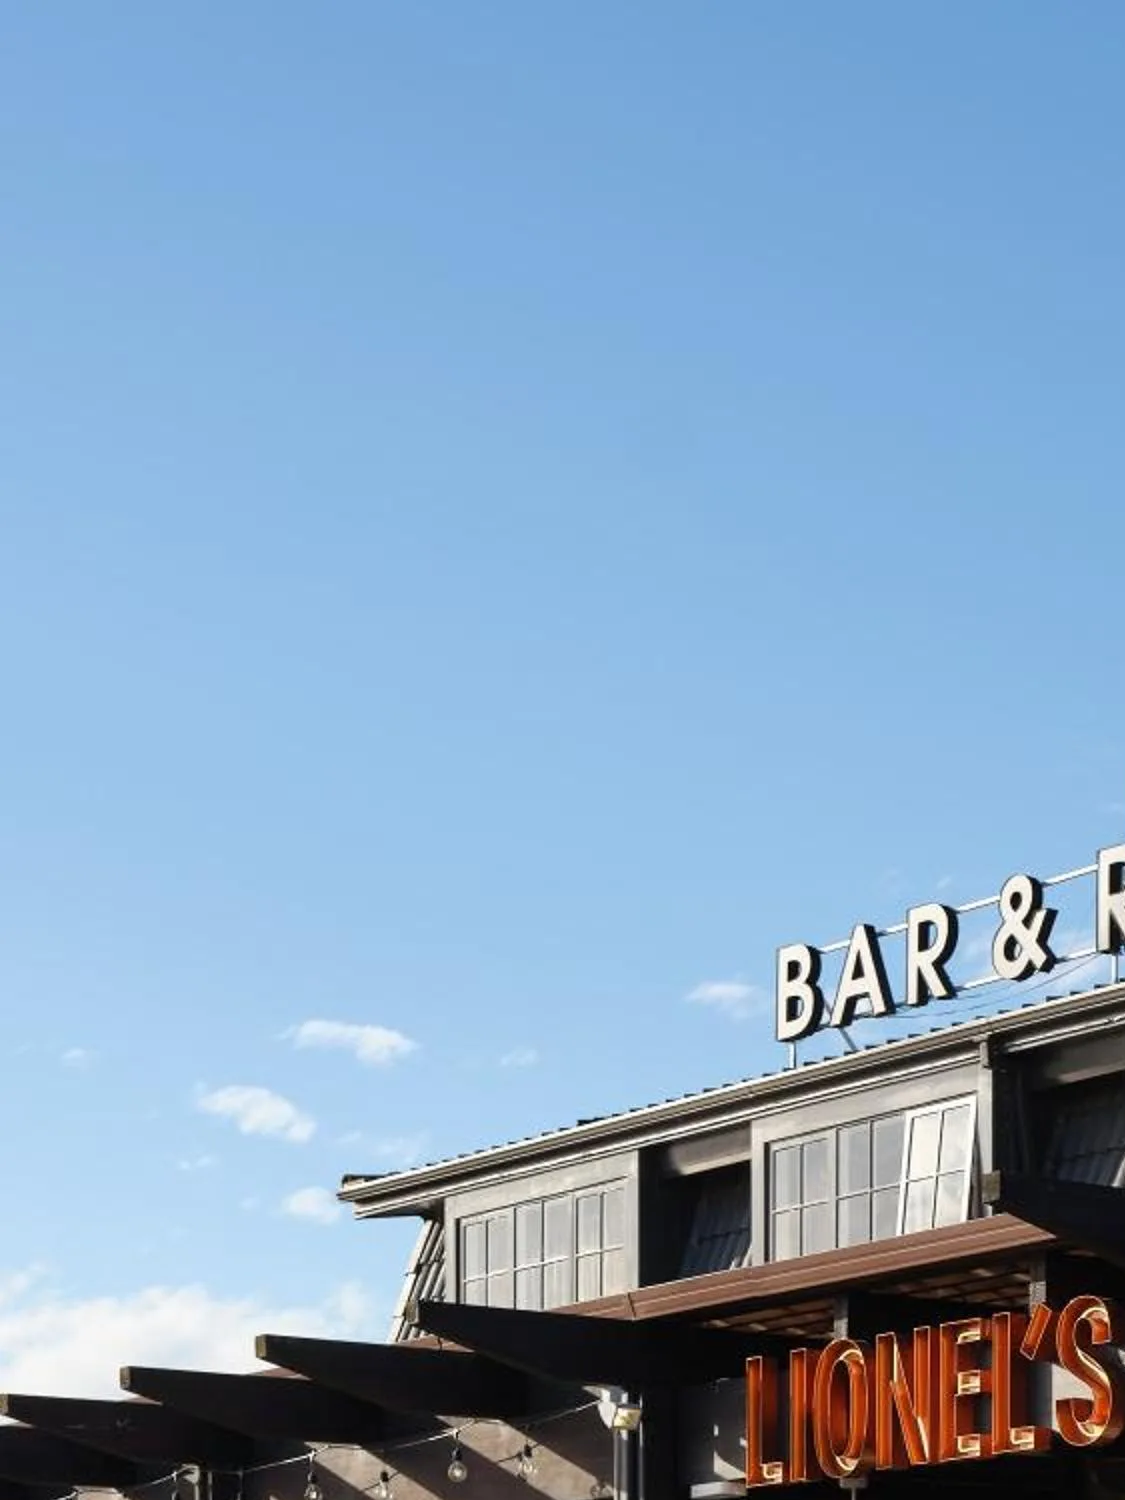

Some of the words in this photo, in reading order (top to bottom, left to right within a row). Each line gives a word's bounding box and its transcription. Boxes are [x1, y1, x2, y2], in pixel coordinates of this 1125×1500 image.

[776, 904, 958, 1042] BAR
[992, 873, 1058, 981] &
[745, 1295, 1116, 1487] LIONEL'S
